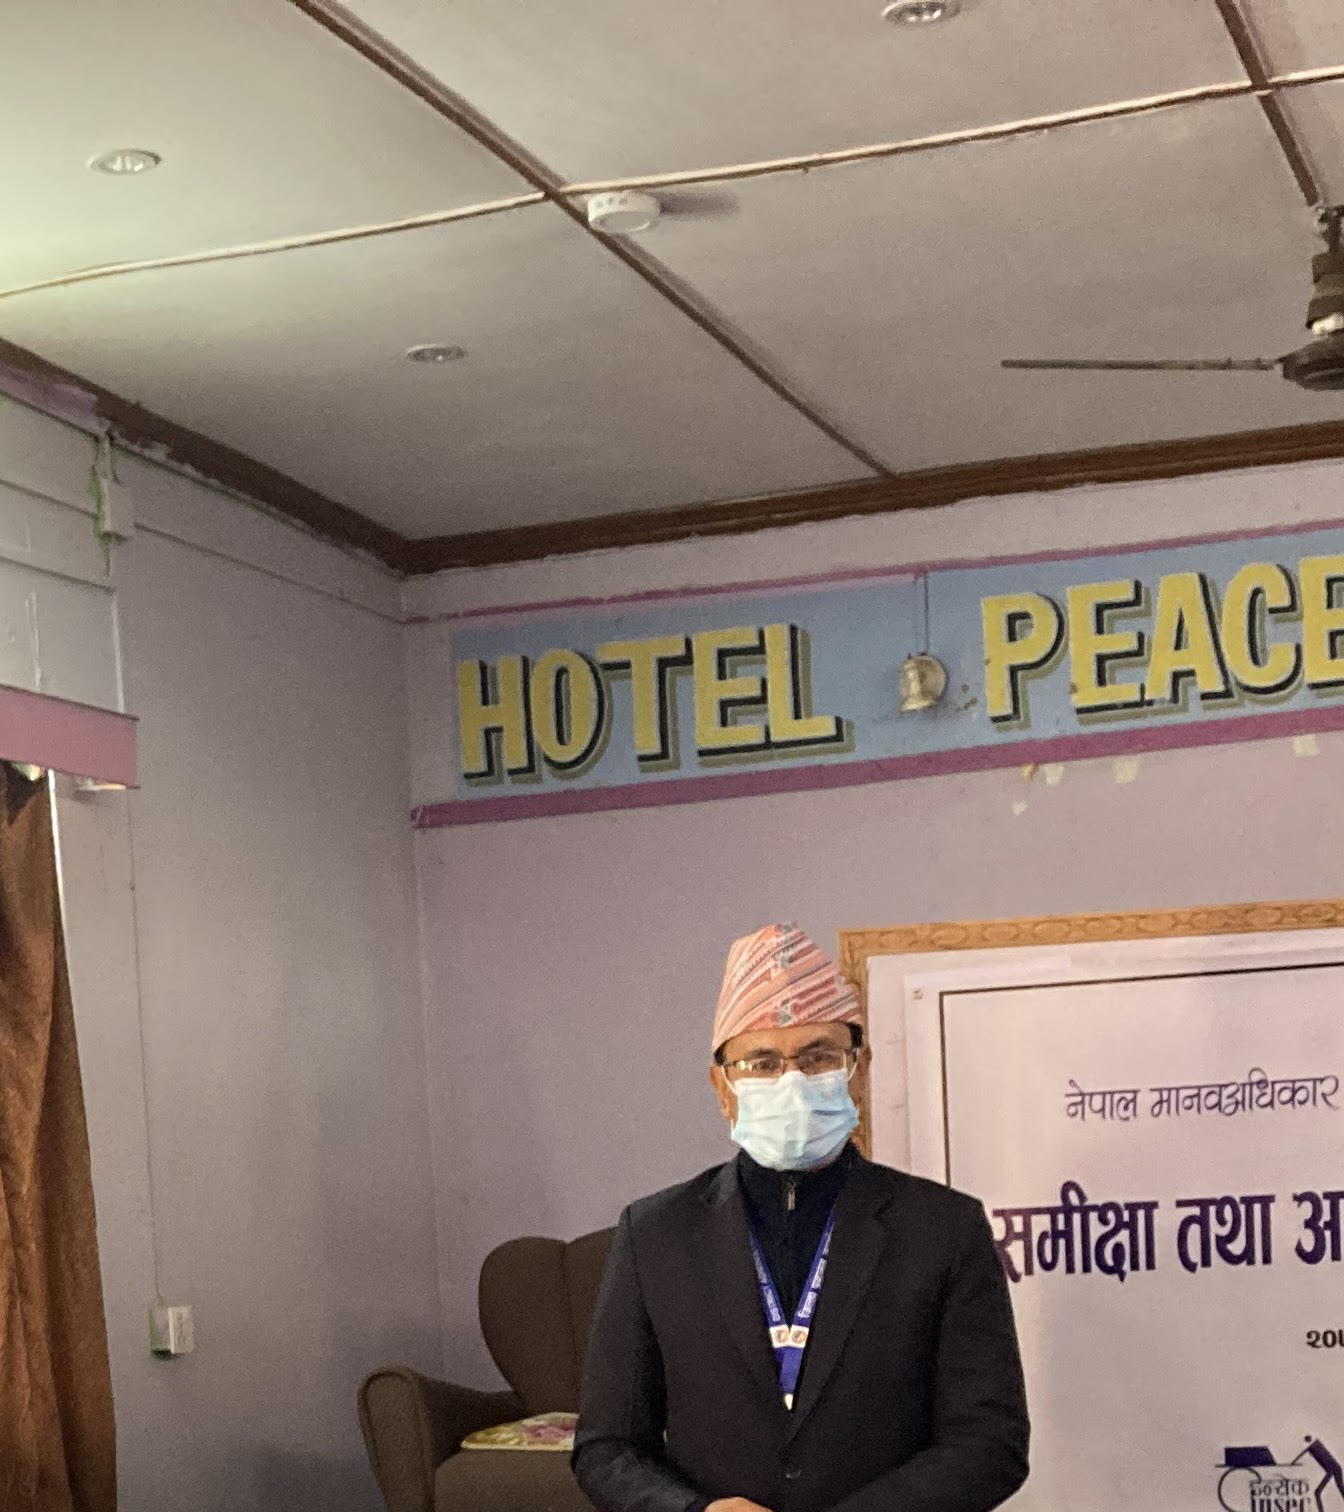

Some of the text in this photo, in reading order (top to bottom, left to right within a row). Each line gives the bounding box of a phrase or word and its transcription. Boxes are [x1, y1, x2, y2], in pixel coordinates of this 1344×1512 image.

[459, 622, 852, 784] HOTEL
[1064, 1079, 1140, 1121] नेपाल
[992, 1180, 1159, 1282] समीक्षा
[1176, 1193, 1276, 1273] तथा
